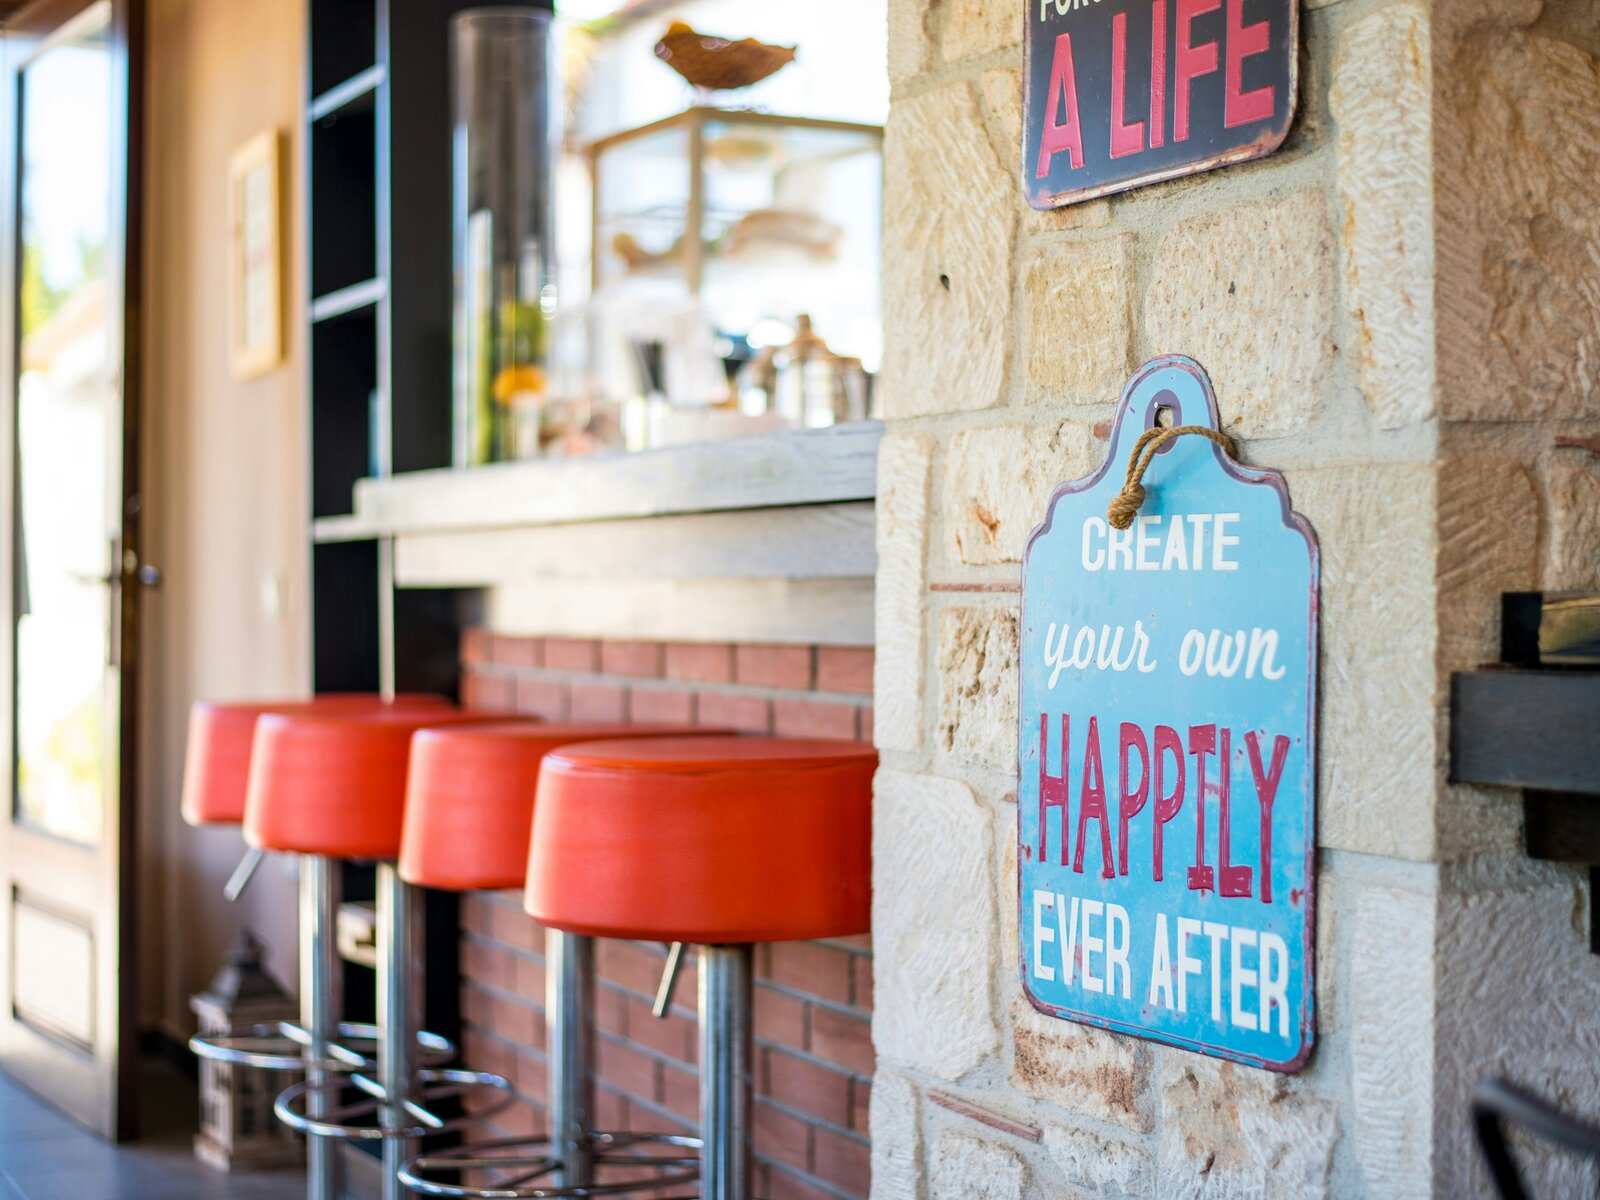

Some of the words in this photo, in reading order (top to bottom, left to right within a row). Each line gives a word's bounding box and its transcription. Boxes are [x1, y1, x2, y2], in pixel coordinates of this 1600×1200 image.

[1036, 32, 1085, 180] A
[1110, 0, 1275, 160] LIFE
[1081, 512, 1241, 572] CREATE
[1043, 620, 1157, 690] your
[1178, 627, 1287, 681] own
[1038, 712, 1291, 904] HAPPILY
[1032, 889, 1132, 1001] EVER
[1148, 912, 1291, 1038] AFTER
